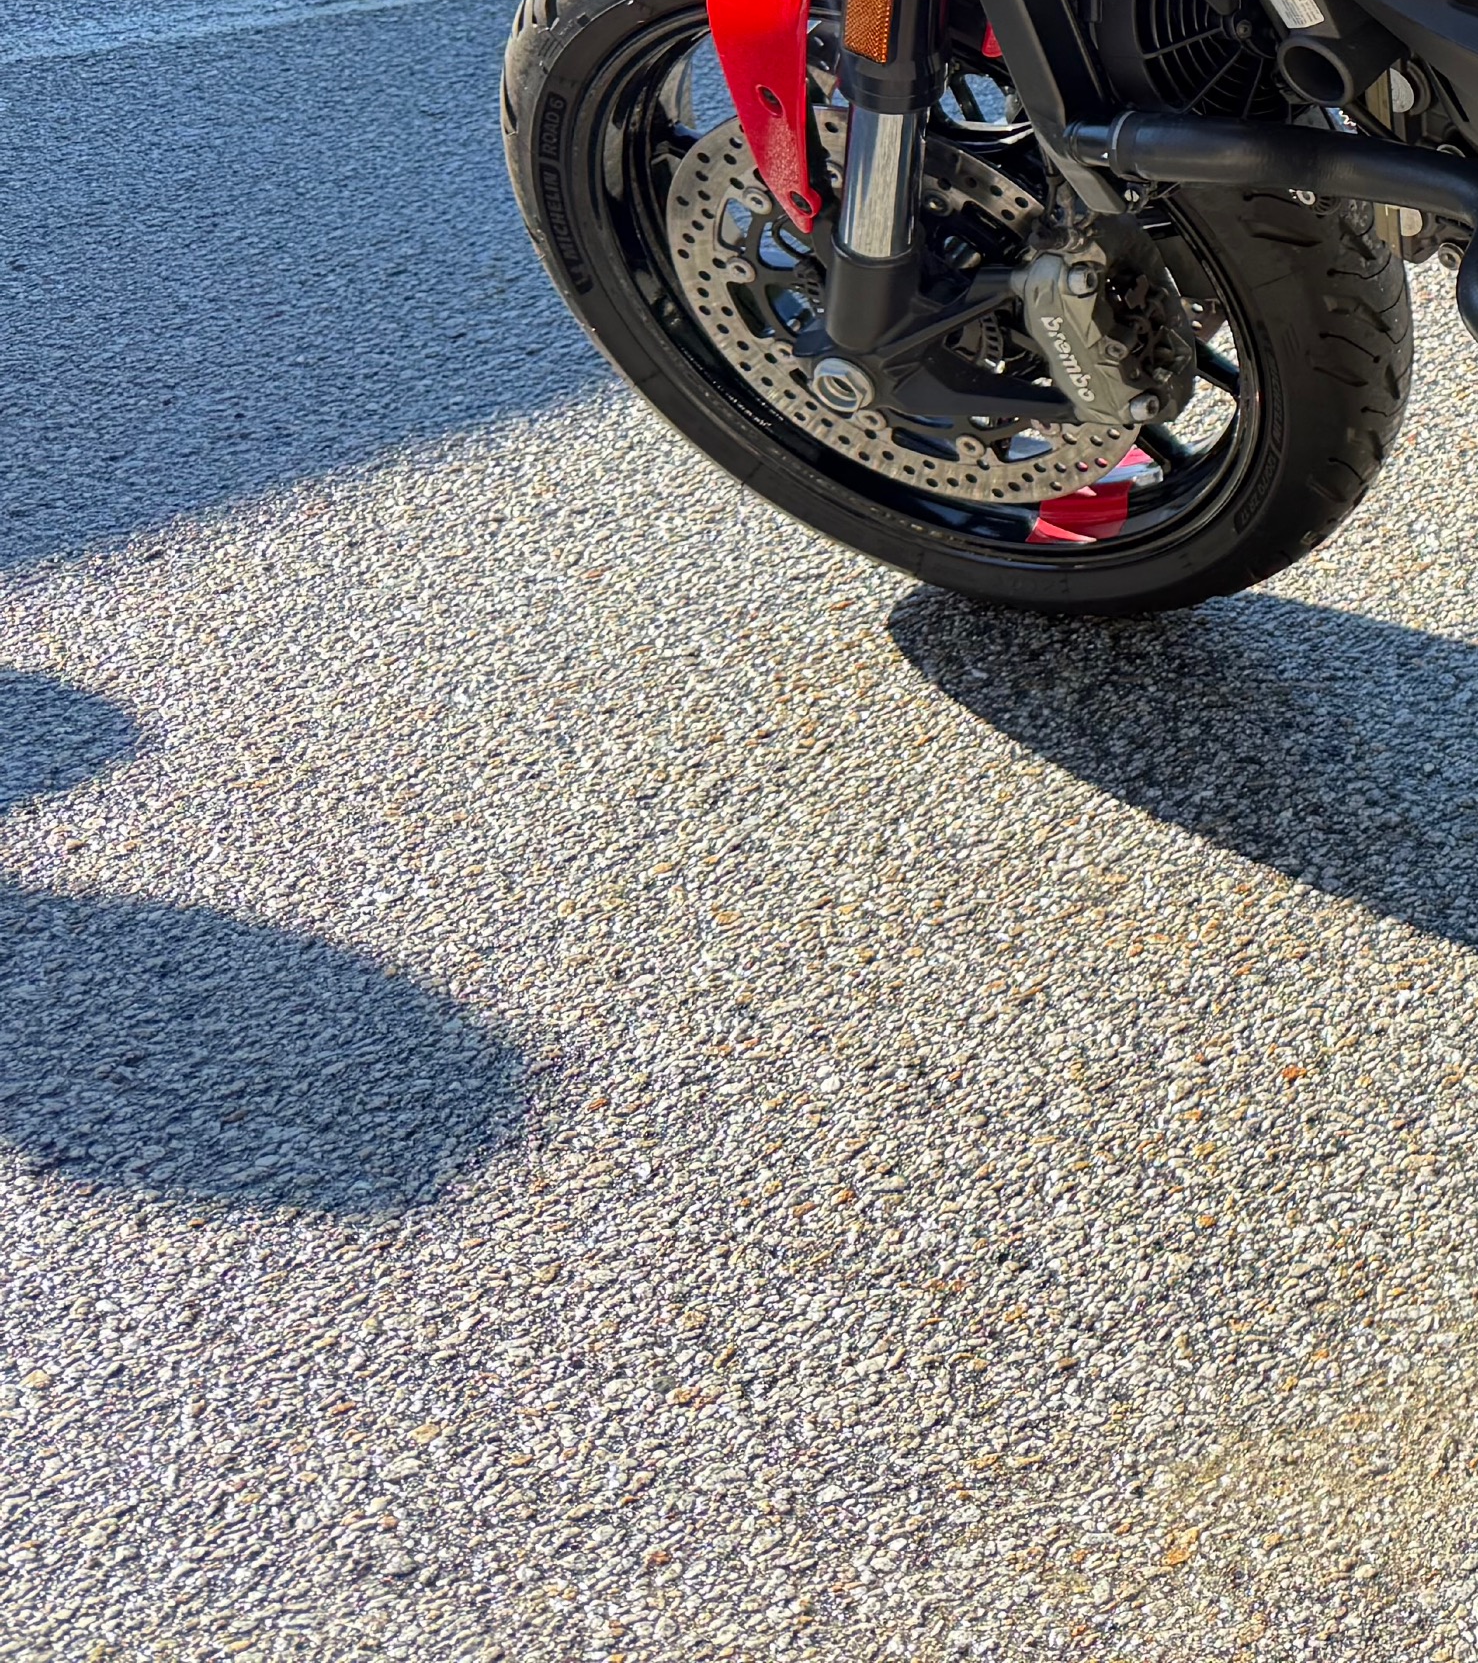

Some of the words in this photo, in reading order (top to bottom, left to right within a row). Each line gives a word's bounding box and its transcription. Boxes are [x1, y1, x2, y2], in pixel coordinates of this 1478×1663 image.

[542, 110, 560, 155] ROAD
[543, 170, 584, 261] MICHELIN
[1041, 316, 1095, 402] brembo
